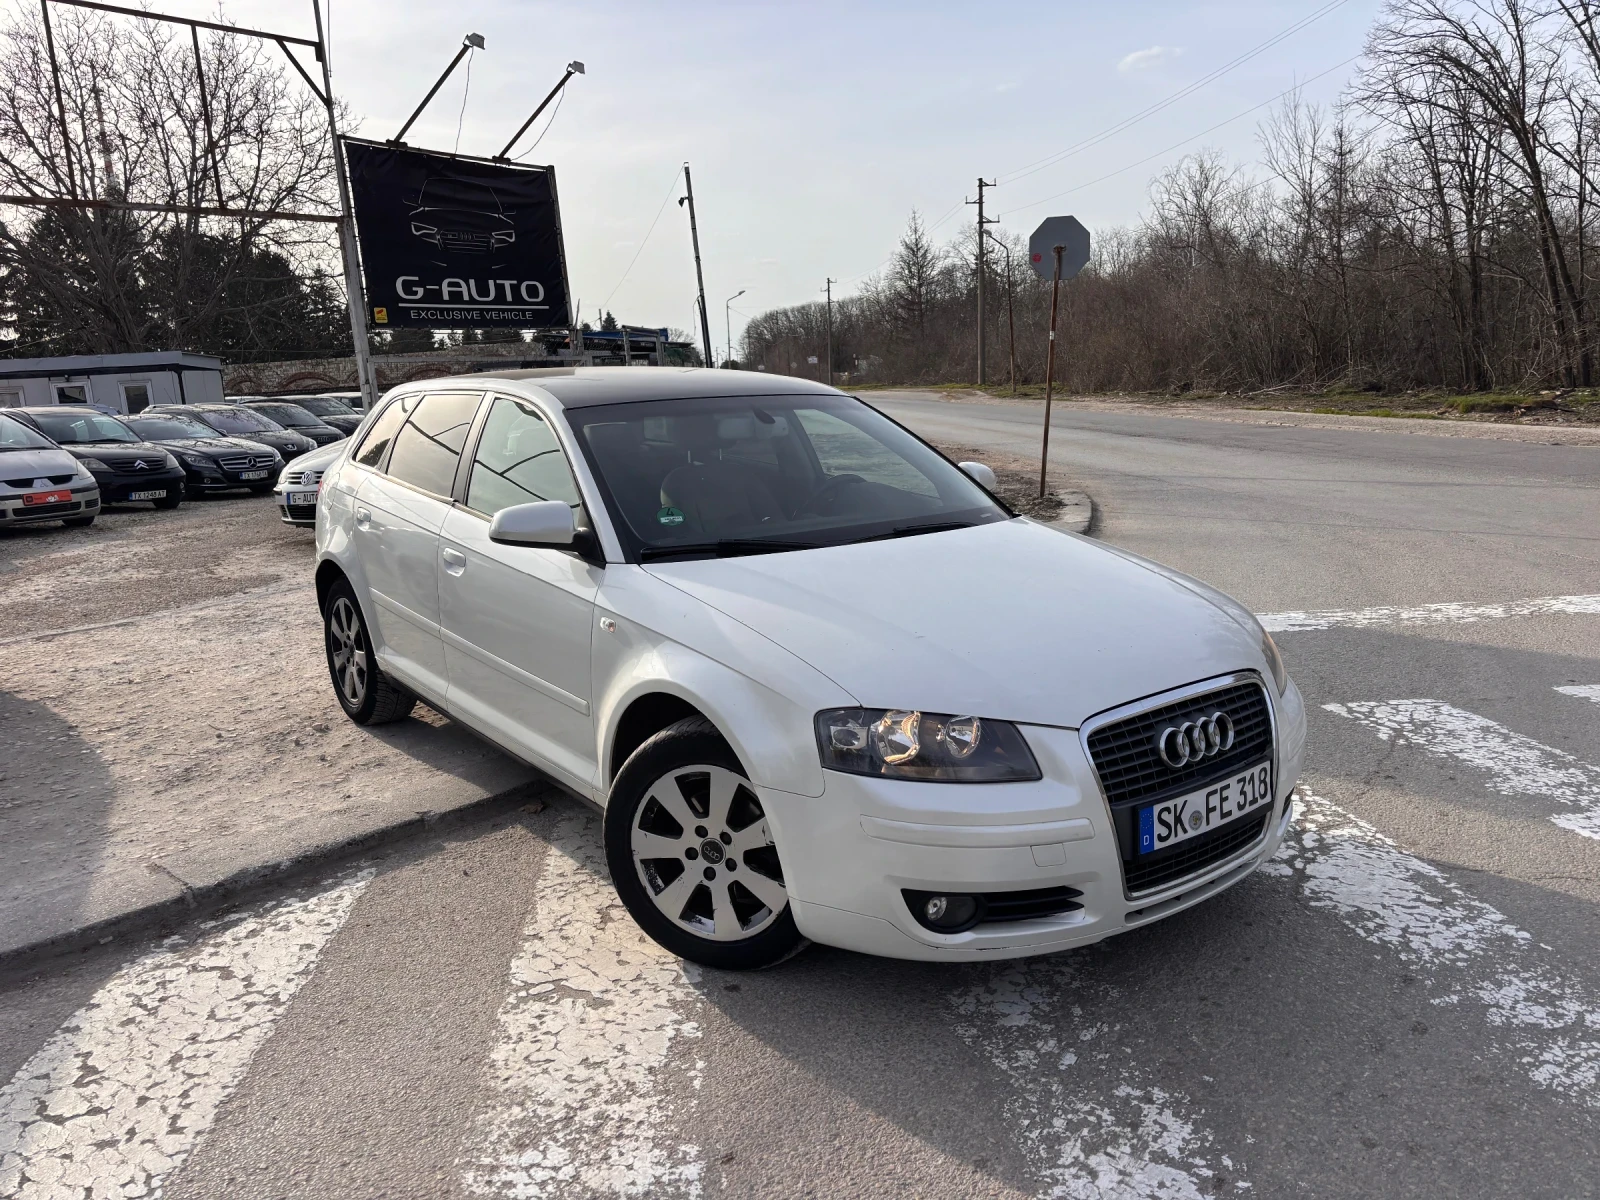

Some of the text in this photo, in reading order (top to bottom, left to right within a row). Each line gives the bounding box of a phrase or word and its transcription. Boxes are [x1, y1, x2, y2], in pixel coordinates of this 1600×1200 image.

[395, 275, 545, 302] G-AUTO
[410, 309, 534, 320] EXCLUSIVE VEHICLE
[1156, 765, 1268, 843] SK FE 318
[1143, 834, 1150, 846] D
